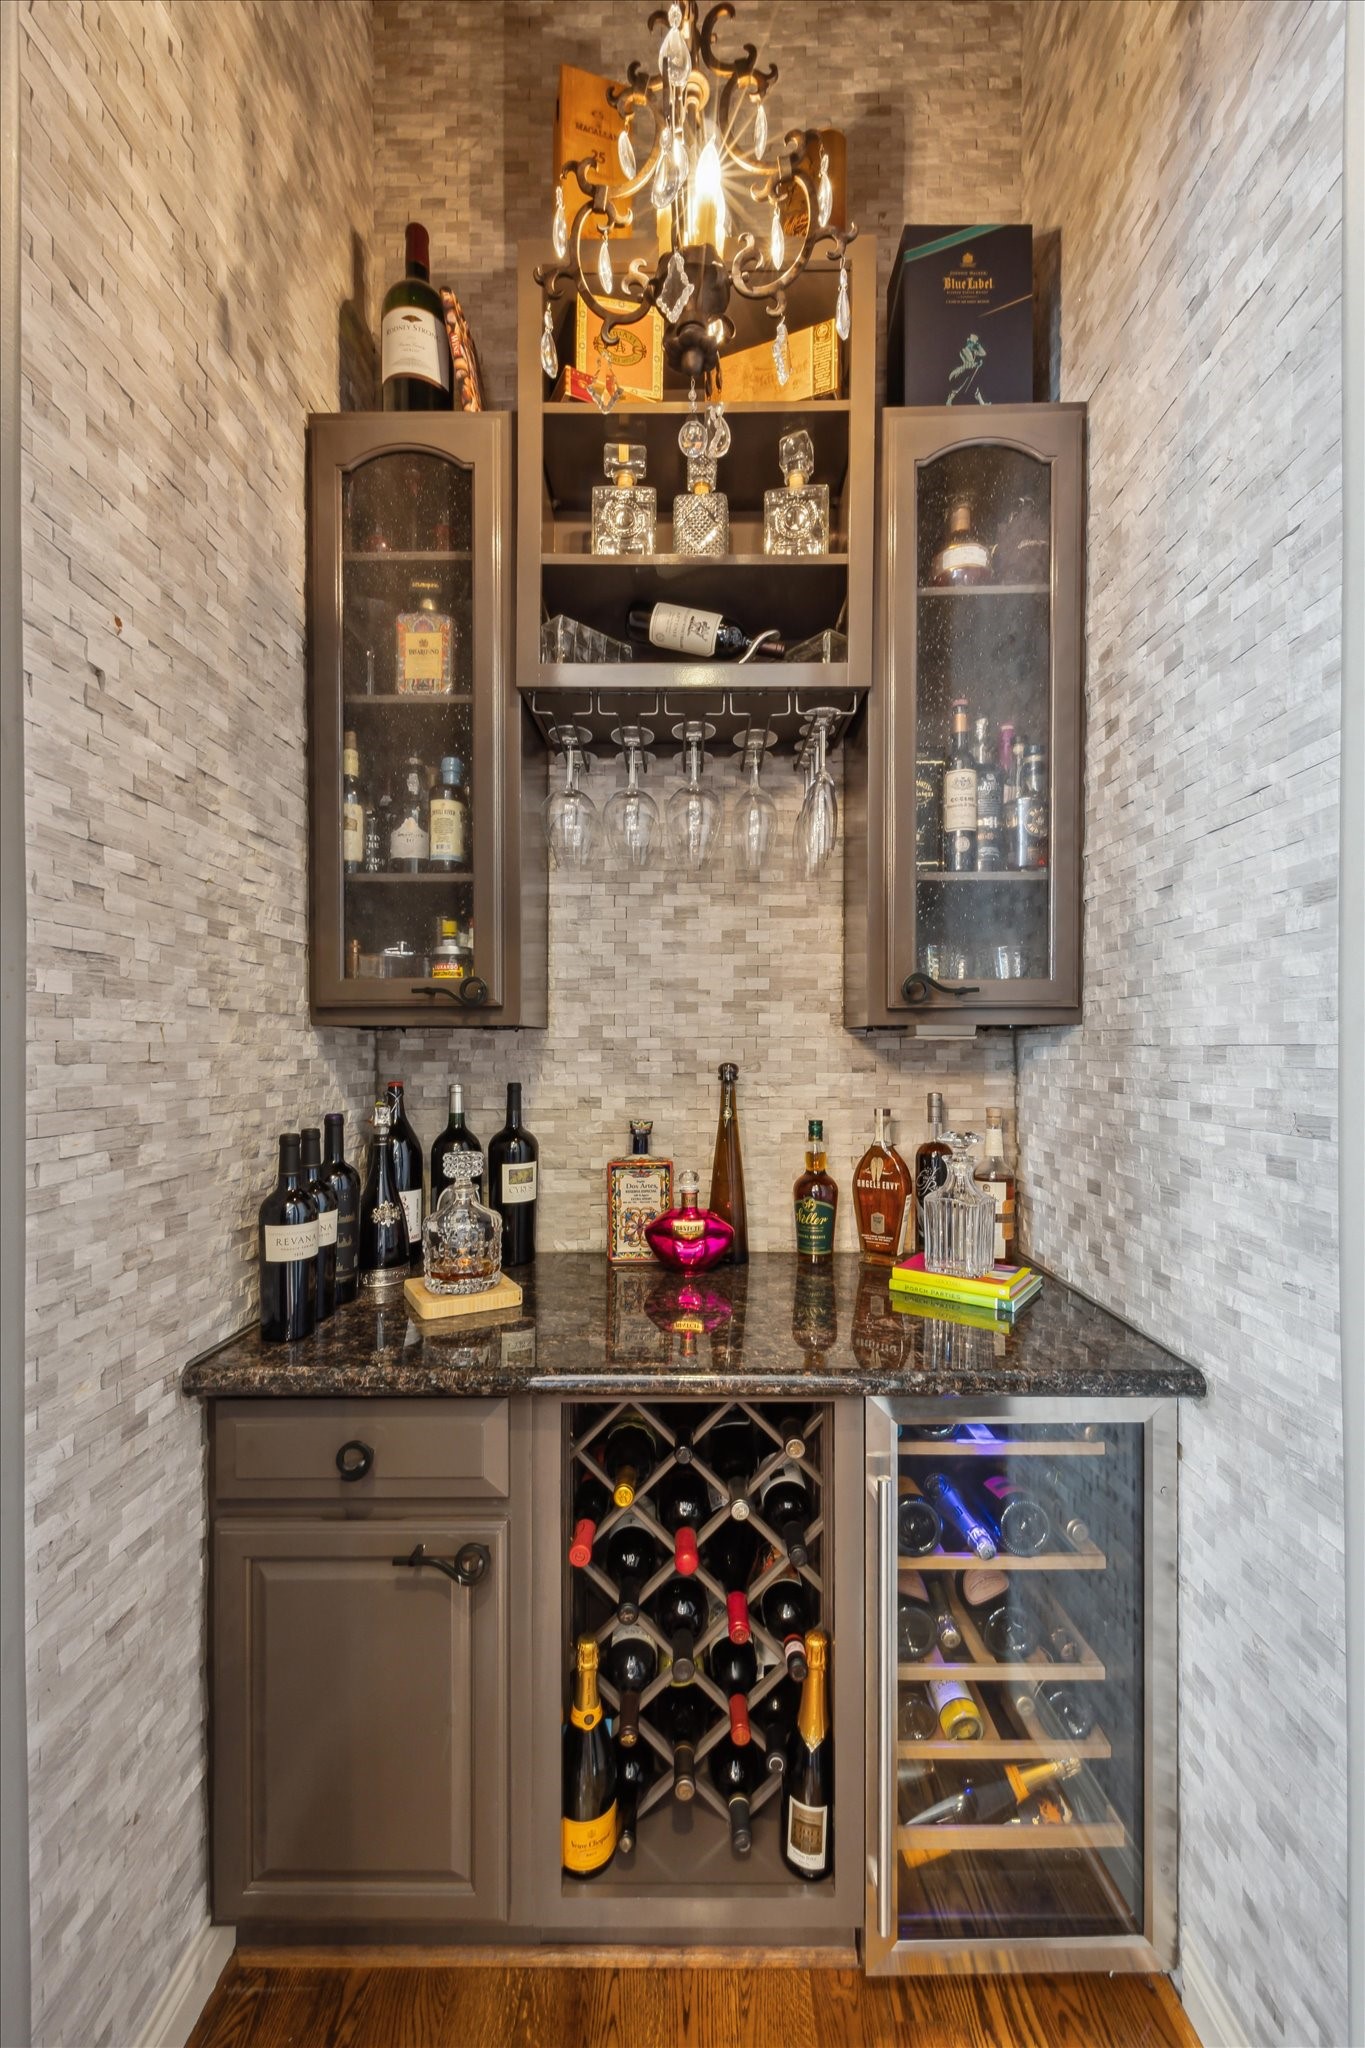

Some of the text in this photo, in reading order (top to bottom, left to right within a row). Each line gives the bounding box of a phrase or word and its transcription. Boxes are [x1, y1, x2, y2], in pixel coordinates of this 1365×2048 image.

[944, 276, 993, 289] Blue Label
[386, 324, 410, 336] RODNEY
[882, 1181, 899, 1190] ENVY
[276, 1234, 317, 1247] REVANA
[904, 1284, 961, 1300] PORCH PARTIES
